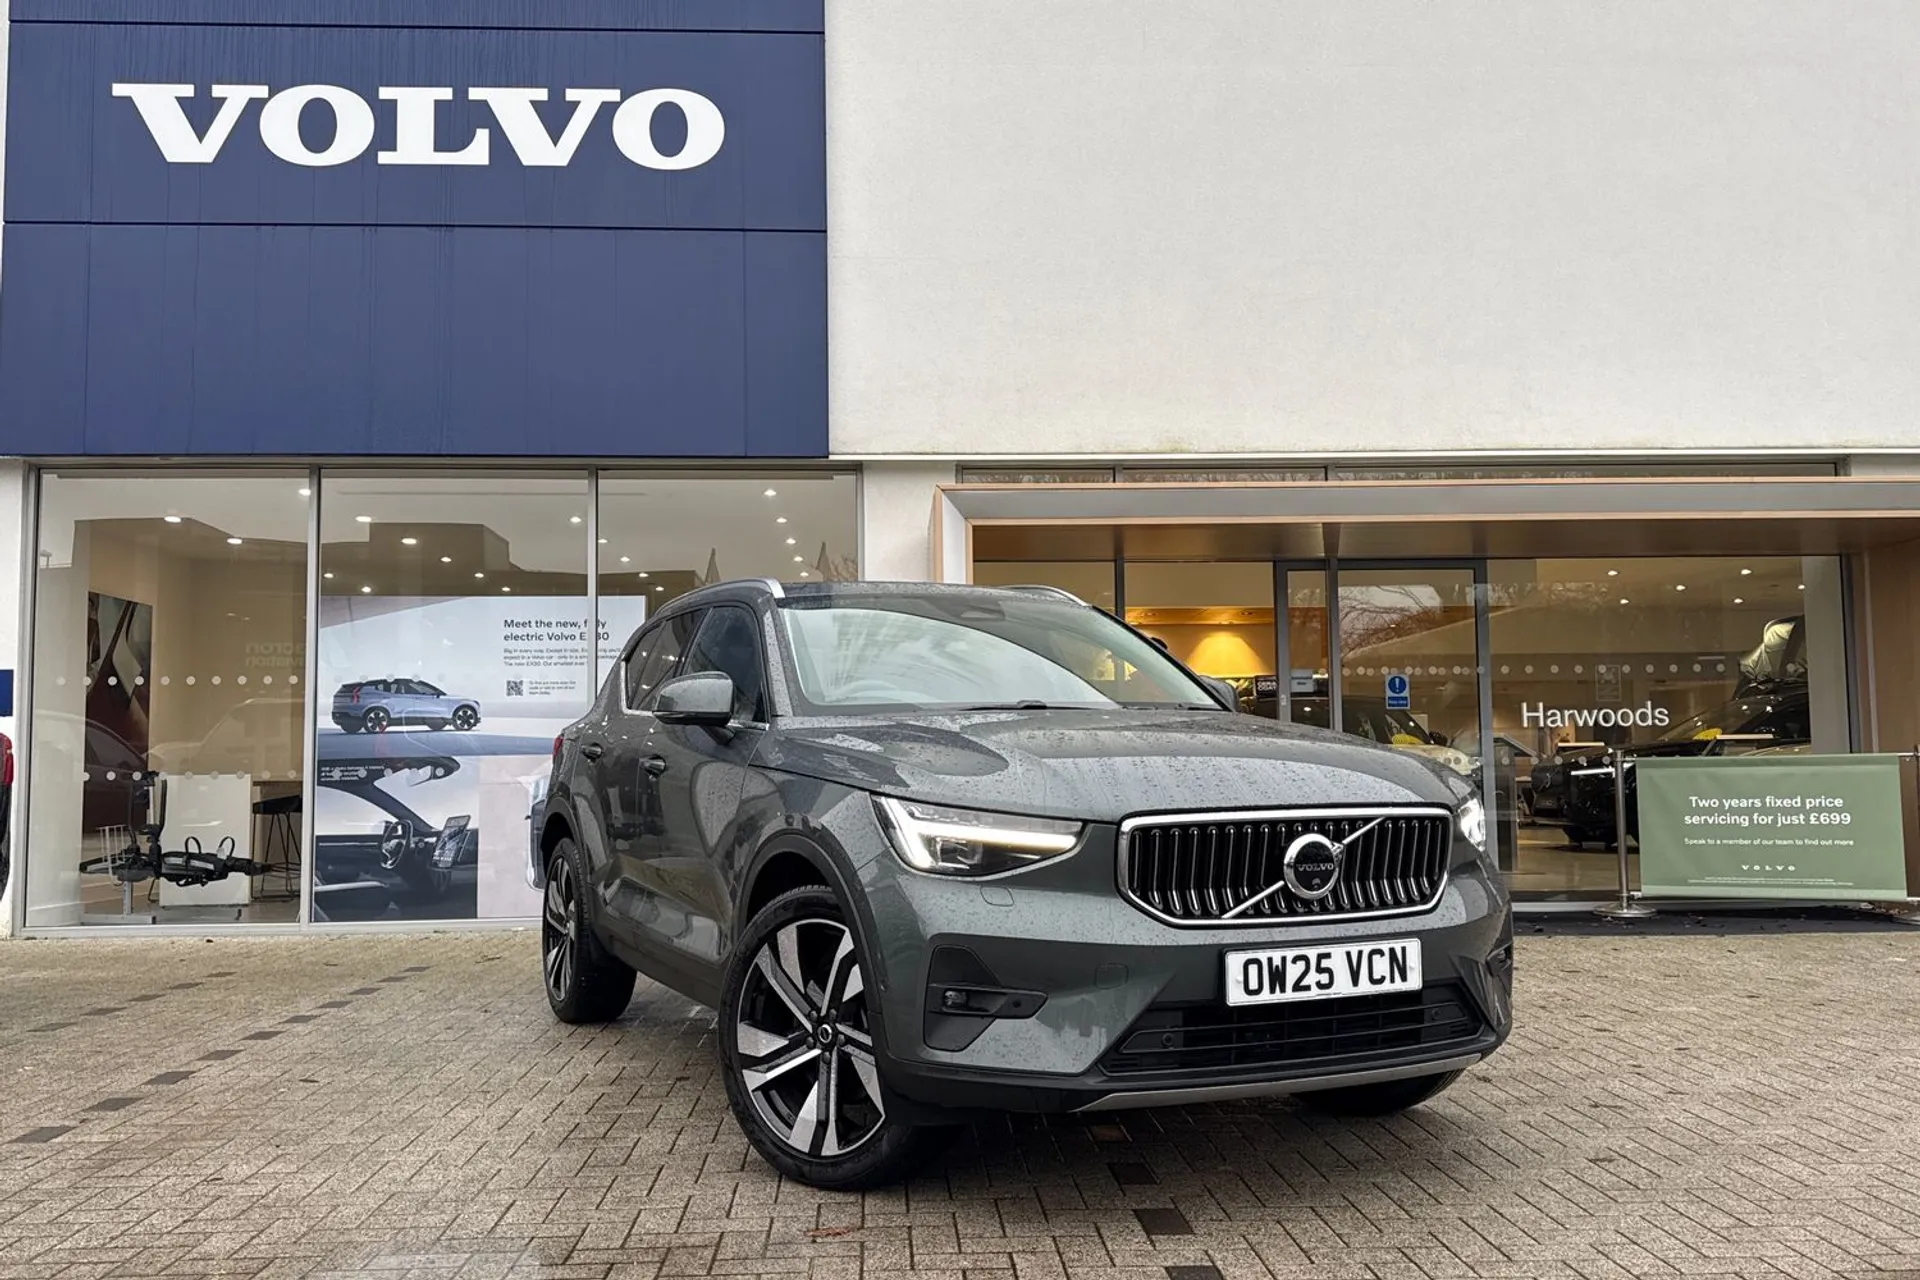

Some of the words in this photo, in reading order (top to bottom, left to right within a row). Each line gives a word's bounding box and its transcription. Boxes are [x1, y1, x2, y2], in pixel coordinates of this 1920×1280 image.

[112, 83, 726, 171] VOLVO
[503, 619, 532, 629] Meet
[535, 619, 552, 629] the
[555, 619, 581, 630] new,
[503, 631, 544, 642] electric
[547, 631, 576, 642] Volvo
[1521, 700, 1670, 728] Harwoods
[1689, 796, 1719, 808] Two
[1722, 798, 1762, 811] years
[1765, 795, 1801, 808] fixed
[1805, 795, 1844, 810] price
[1684, 812, 1750, 827] servicing
[1753, 812, 1774, 825] for
[1776, 812, 1806, 828] just
[1809, 812, 1852, 825] £699
[1684, 837, 1706, 847] Speak
[1722, 838, 1751, 846] member
[1804, 838, 1819, 846] find
[1296, 862, 1334, 872] VOLVO
[1741, 864, 1796, 872] VOLVO
[1242, 952, 1335, 996] OW25
[1345, 946, 1408, 988] VCN
